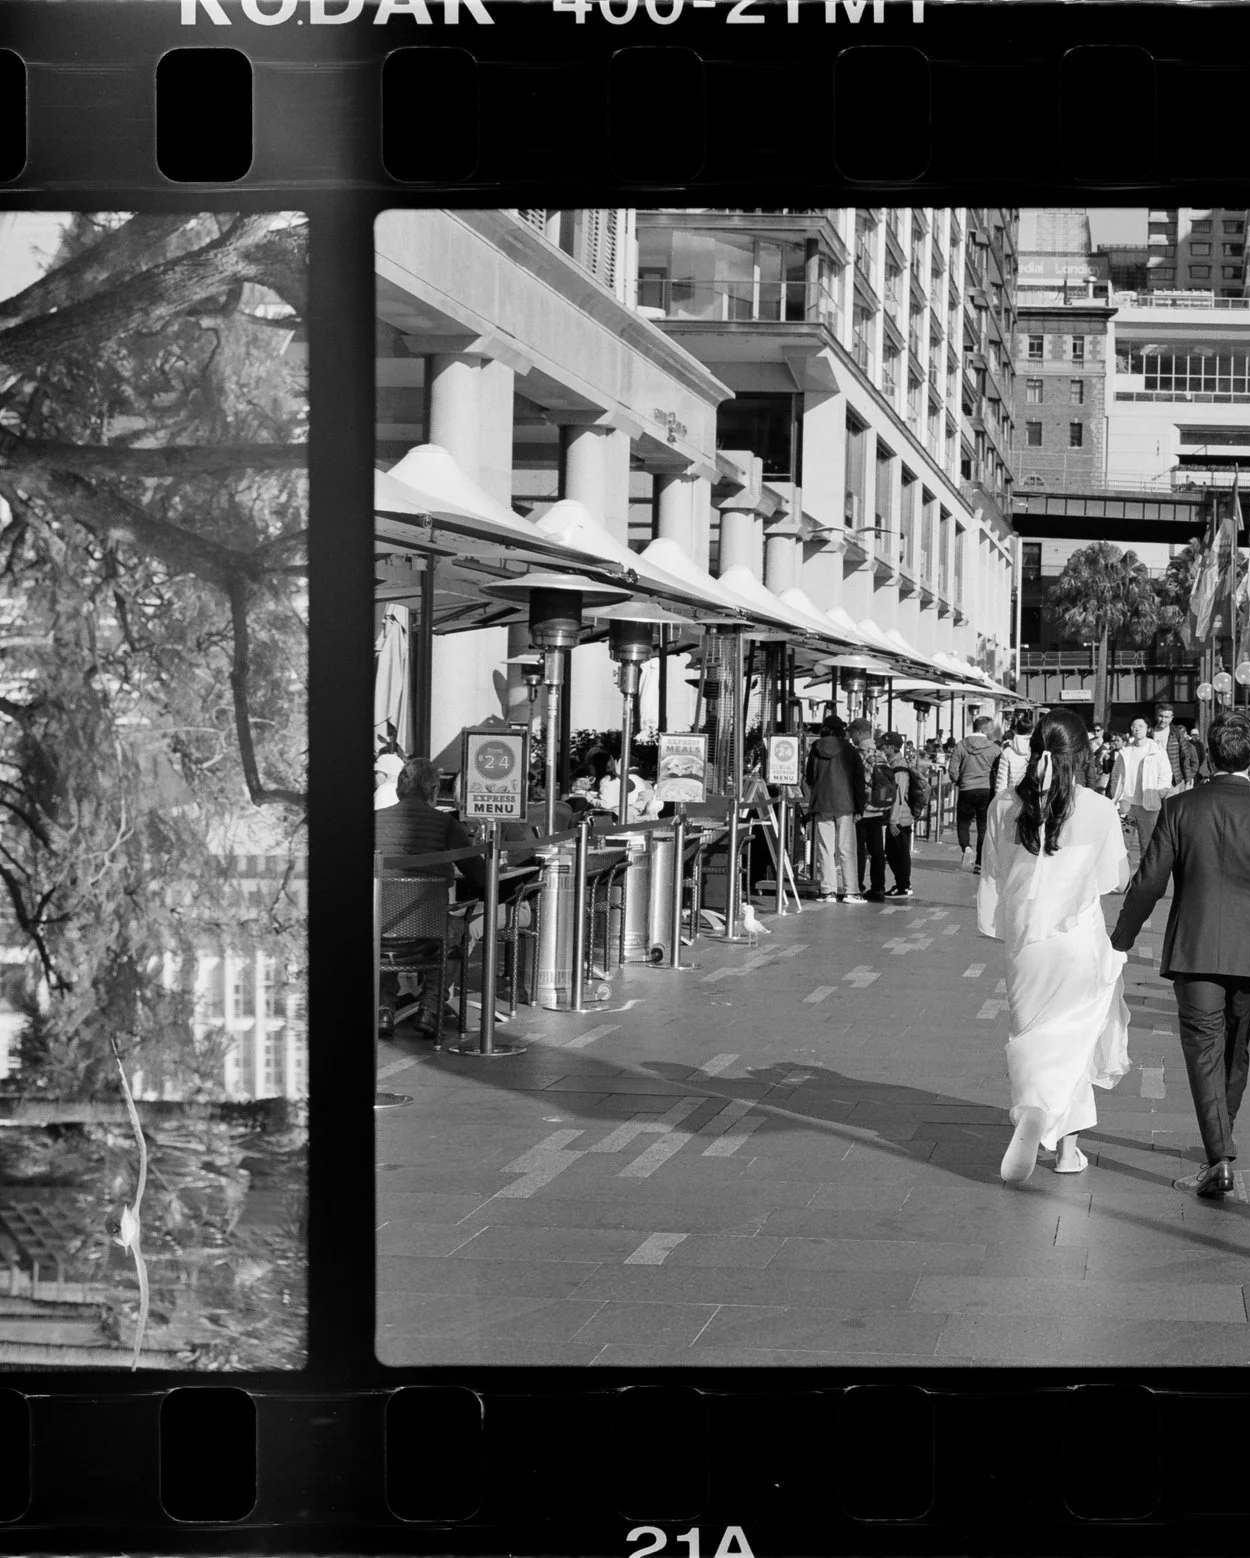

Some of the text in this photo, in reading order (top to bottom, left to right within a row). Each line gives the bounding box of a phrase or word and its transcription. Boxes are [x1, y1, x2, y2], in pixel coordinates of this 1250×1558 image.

[667, 745, 701, 753] MEALS
[473, 795, 516, 803] EXPRESS
[474, 803, 514, 813] MENU
[626, 1525, 756, 1558] 21A
